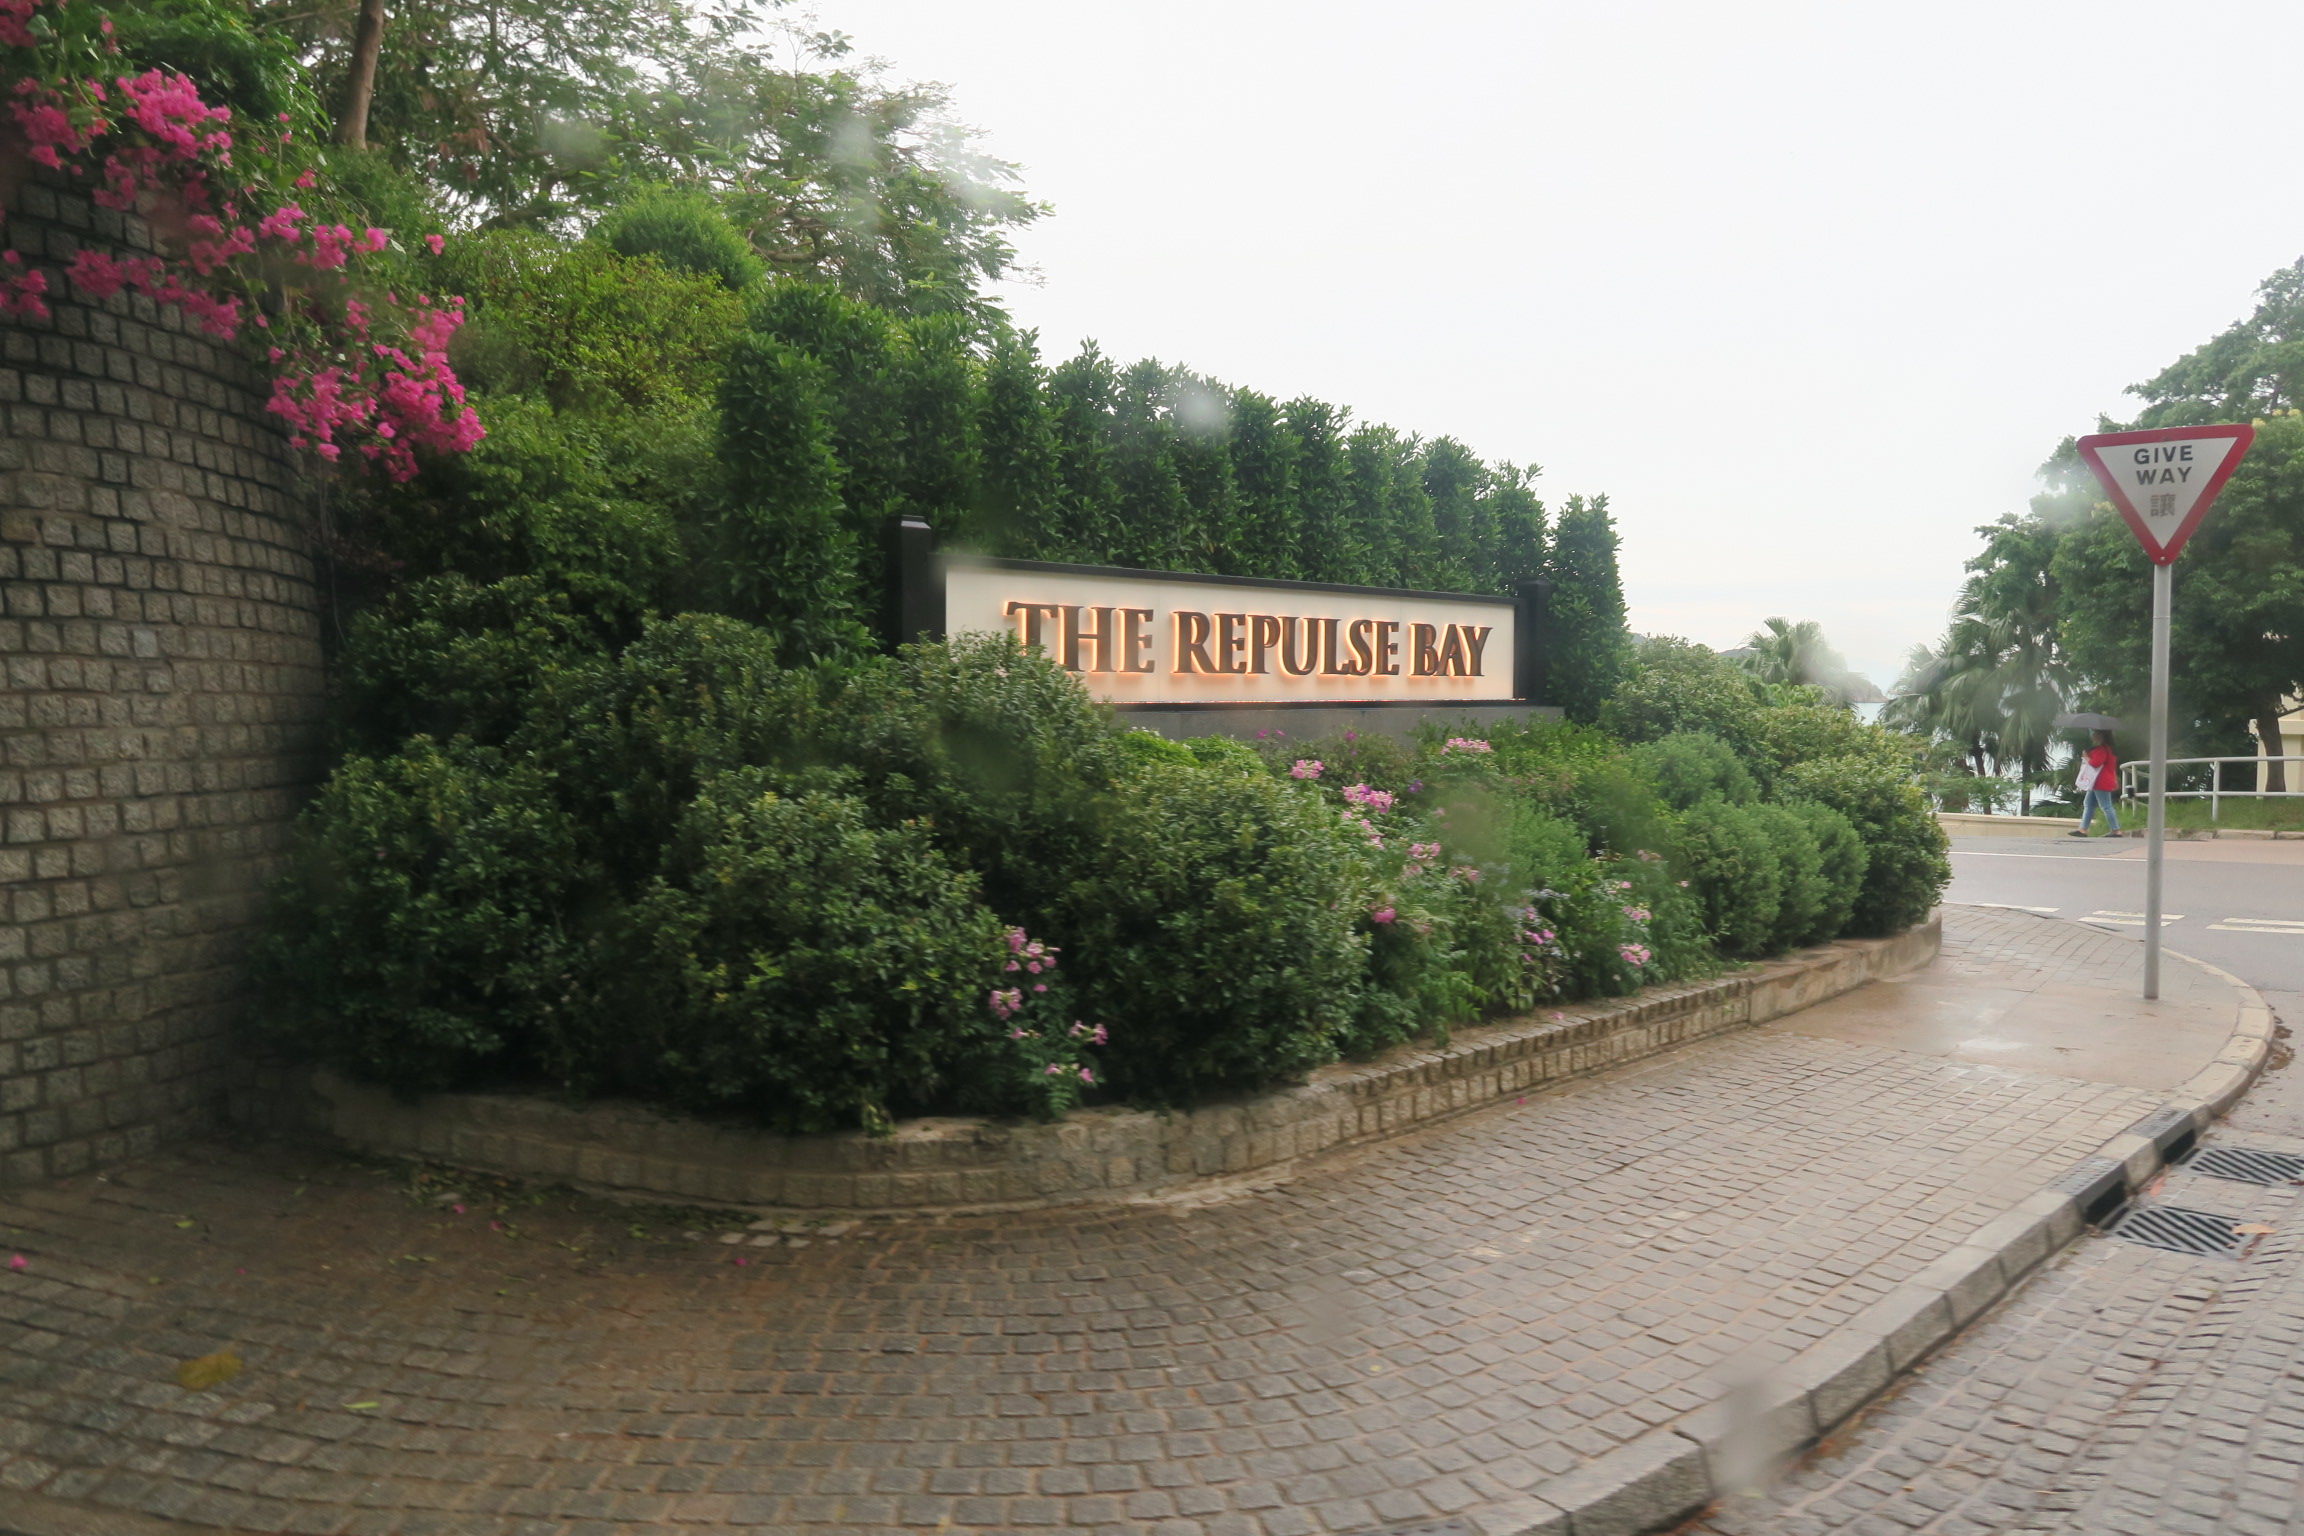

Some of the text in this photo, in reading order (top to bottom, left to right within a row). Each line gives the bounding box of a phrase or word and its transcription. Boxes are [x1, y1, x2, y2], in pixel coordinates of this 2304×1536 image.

[2134, 445, 2193, 465] GIVE
[2136, 467, 2192, 485] WAY
[2150, 493, 2176, 517] 讓
[1004, 601, 1493, 677] THE REPULSE BAY
